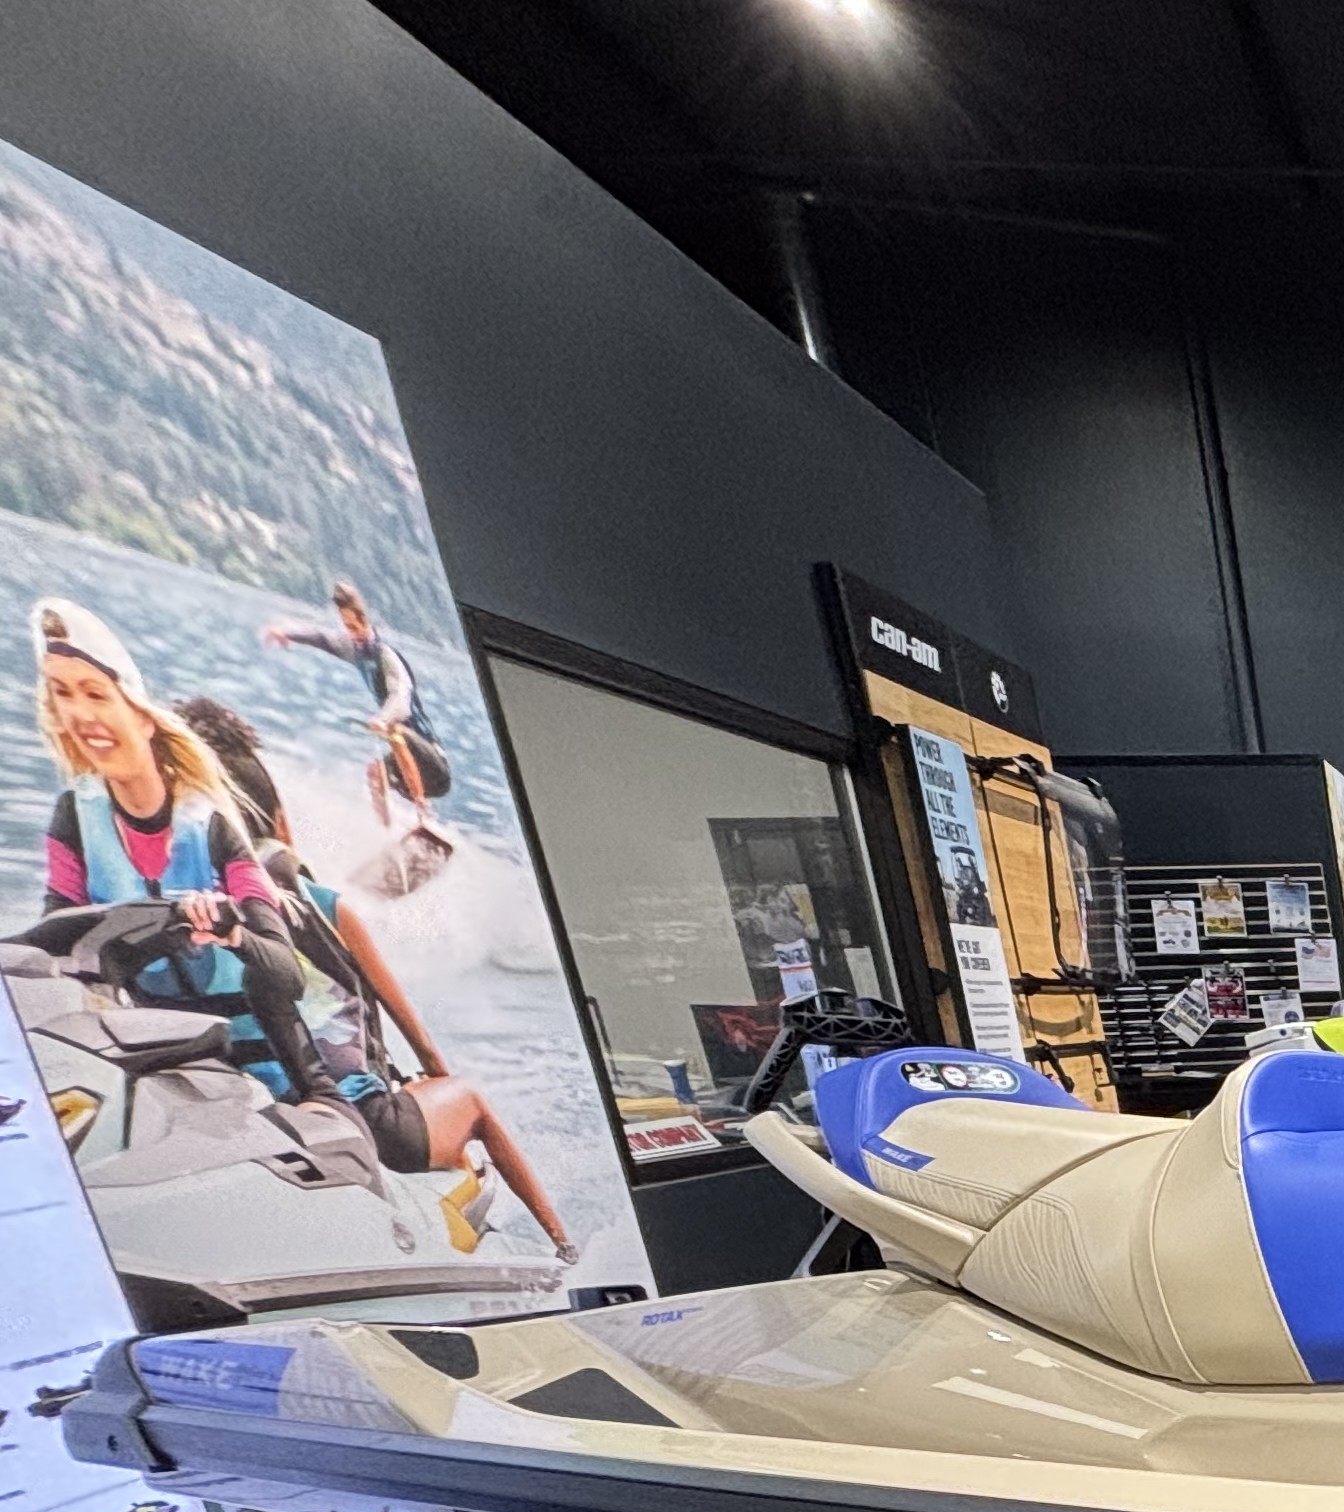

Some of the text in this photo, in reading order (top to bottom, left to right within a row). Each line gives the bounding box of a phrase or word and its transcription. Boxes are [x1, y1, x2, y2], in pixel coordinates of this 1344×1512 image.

[870, 615, 942, 674] can-am
[913, 733, 944, 765] POWER
[640, 1309, 684, 1327] ROTAX
